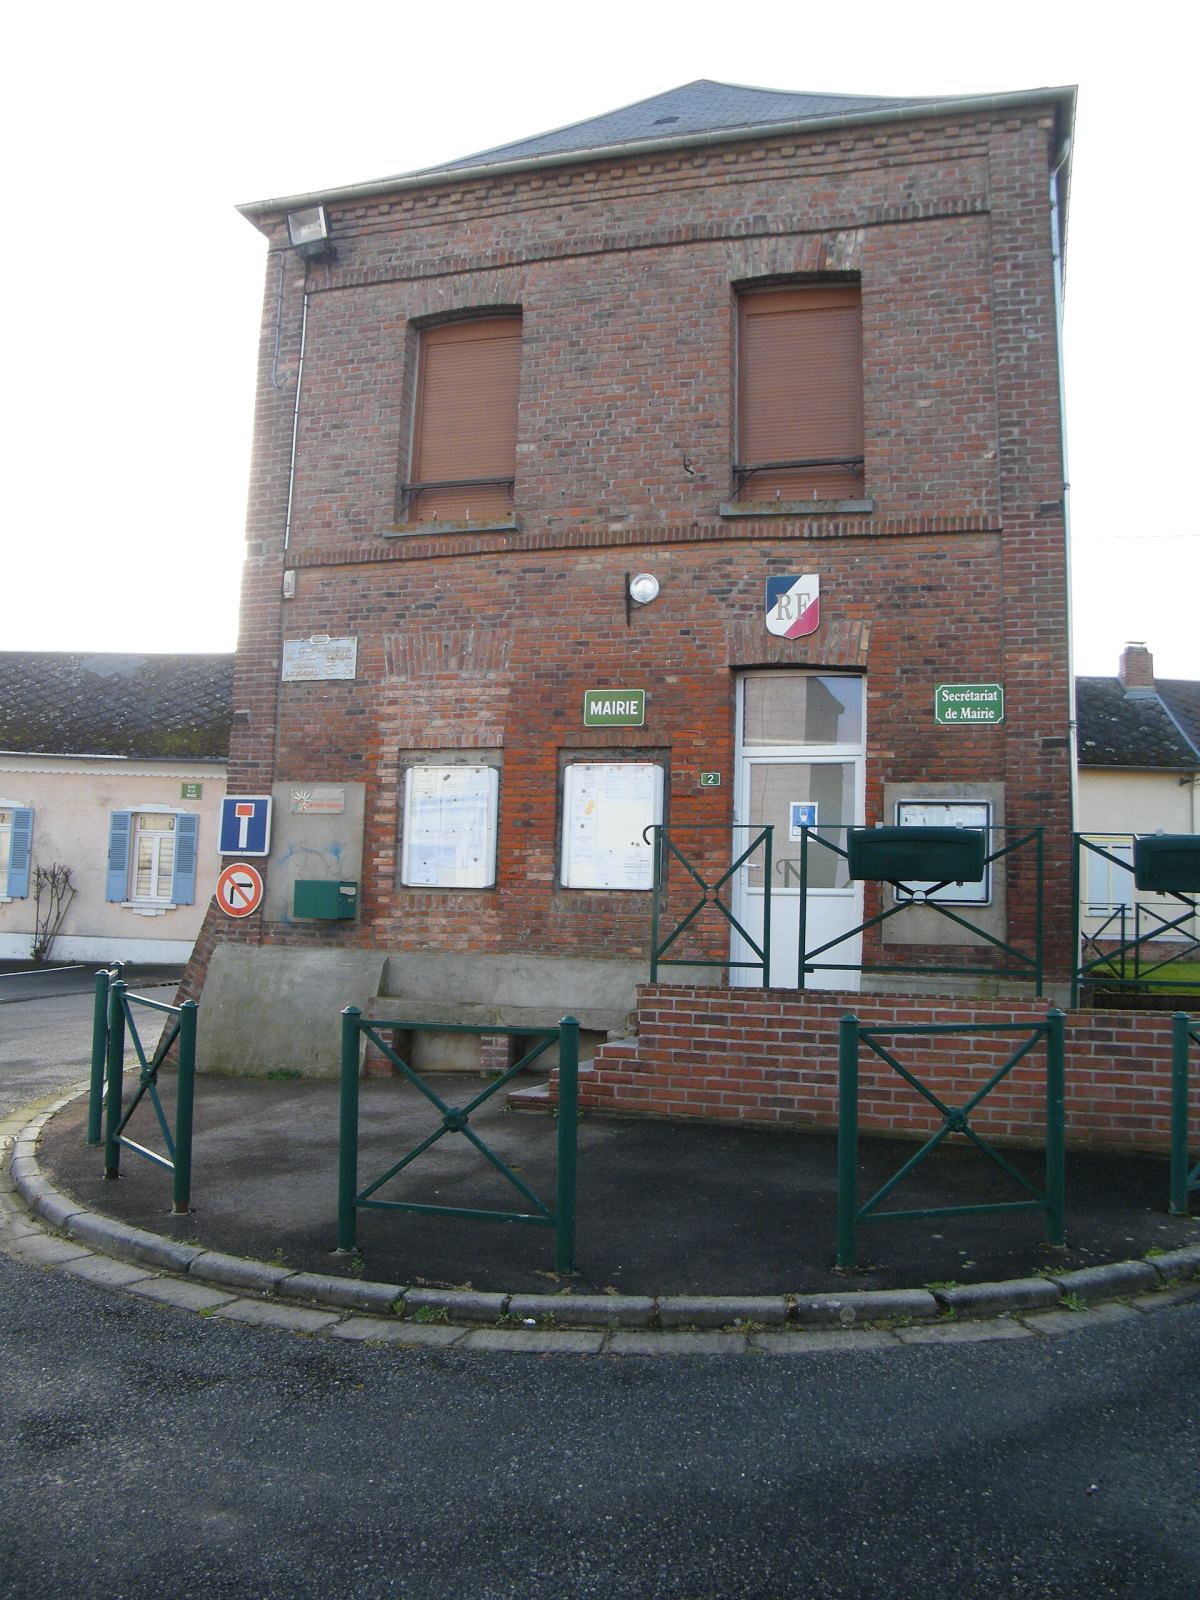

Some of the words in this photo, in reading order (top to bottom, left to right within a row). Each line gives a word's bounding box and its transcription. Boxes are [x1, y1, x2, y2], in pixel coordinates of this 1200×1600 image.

[775, 592, 811, 621] RF
[942, 689, 998, 702] Secrétariat
[590, 701, 639, 715] MAIRIE
[945, 708, 957, 719] de
[960, 707, 995, 719] Mairie
[707, 774, 714, 784] 2
